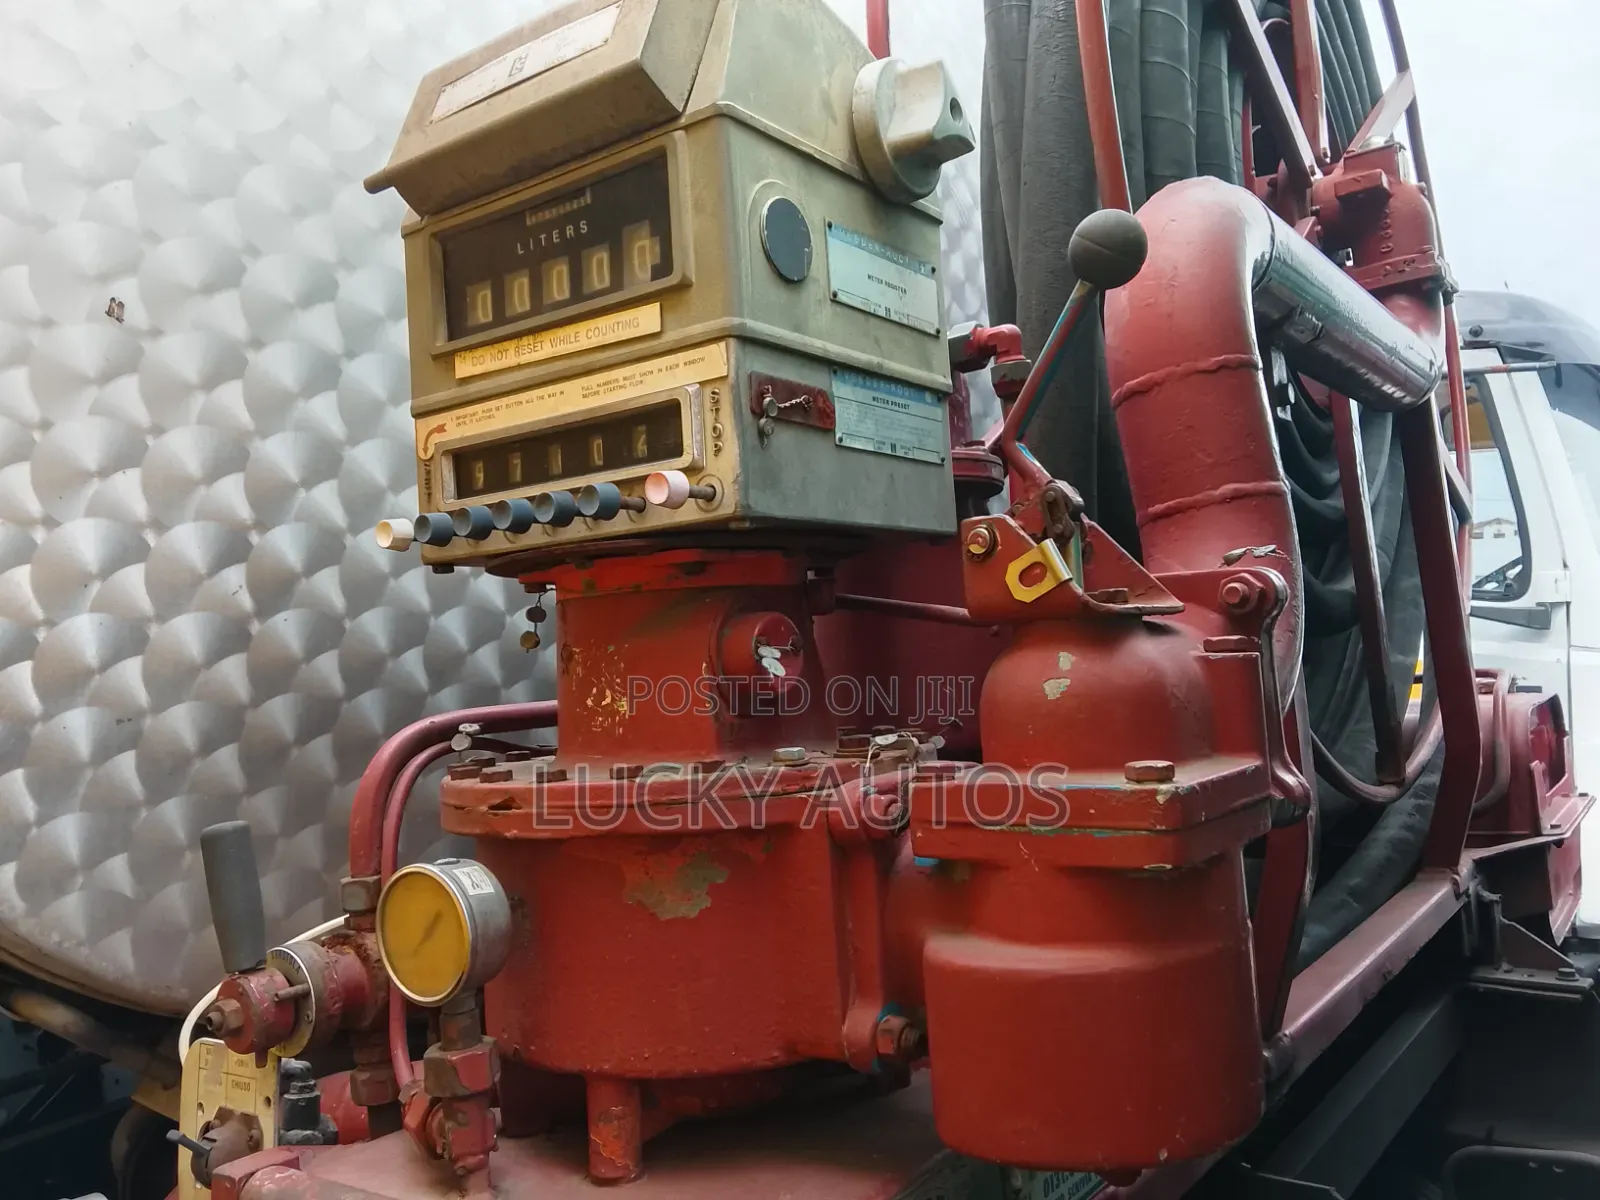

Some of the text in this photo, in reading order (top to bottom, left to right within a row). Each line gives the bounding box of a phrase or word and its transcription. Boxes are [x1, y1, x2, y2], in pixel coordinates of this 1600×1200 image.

[517, 220, 589, 255] LITERS
[867, 273, 884, 285] METER
[471, 316, 641, 368] DO NOT RESET WHILE COUNTING
[596, 378, 620, 388] NUMBERS
[622, 373, 637, 382] MUST
[639, 370, 654, 378] SHOW
[665, 363, 680, 371] EACH
[683, 356, 706, 367] WINDOW
[582, 389, 600, 398] BEFORE
[603, 383, 627, 394] STARTING
[505, 401, 523, 409] BUTTON
[872, 396, 910, 410] METER PRESET
[710, 388, 723, 457] STOP
[231, 1078, 251, 1092] CHIUSO
